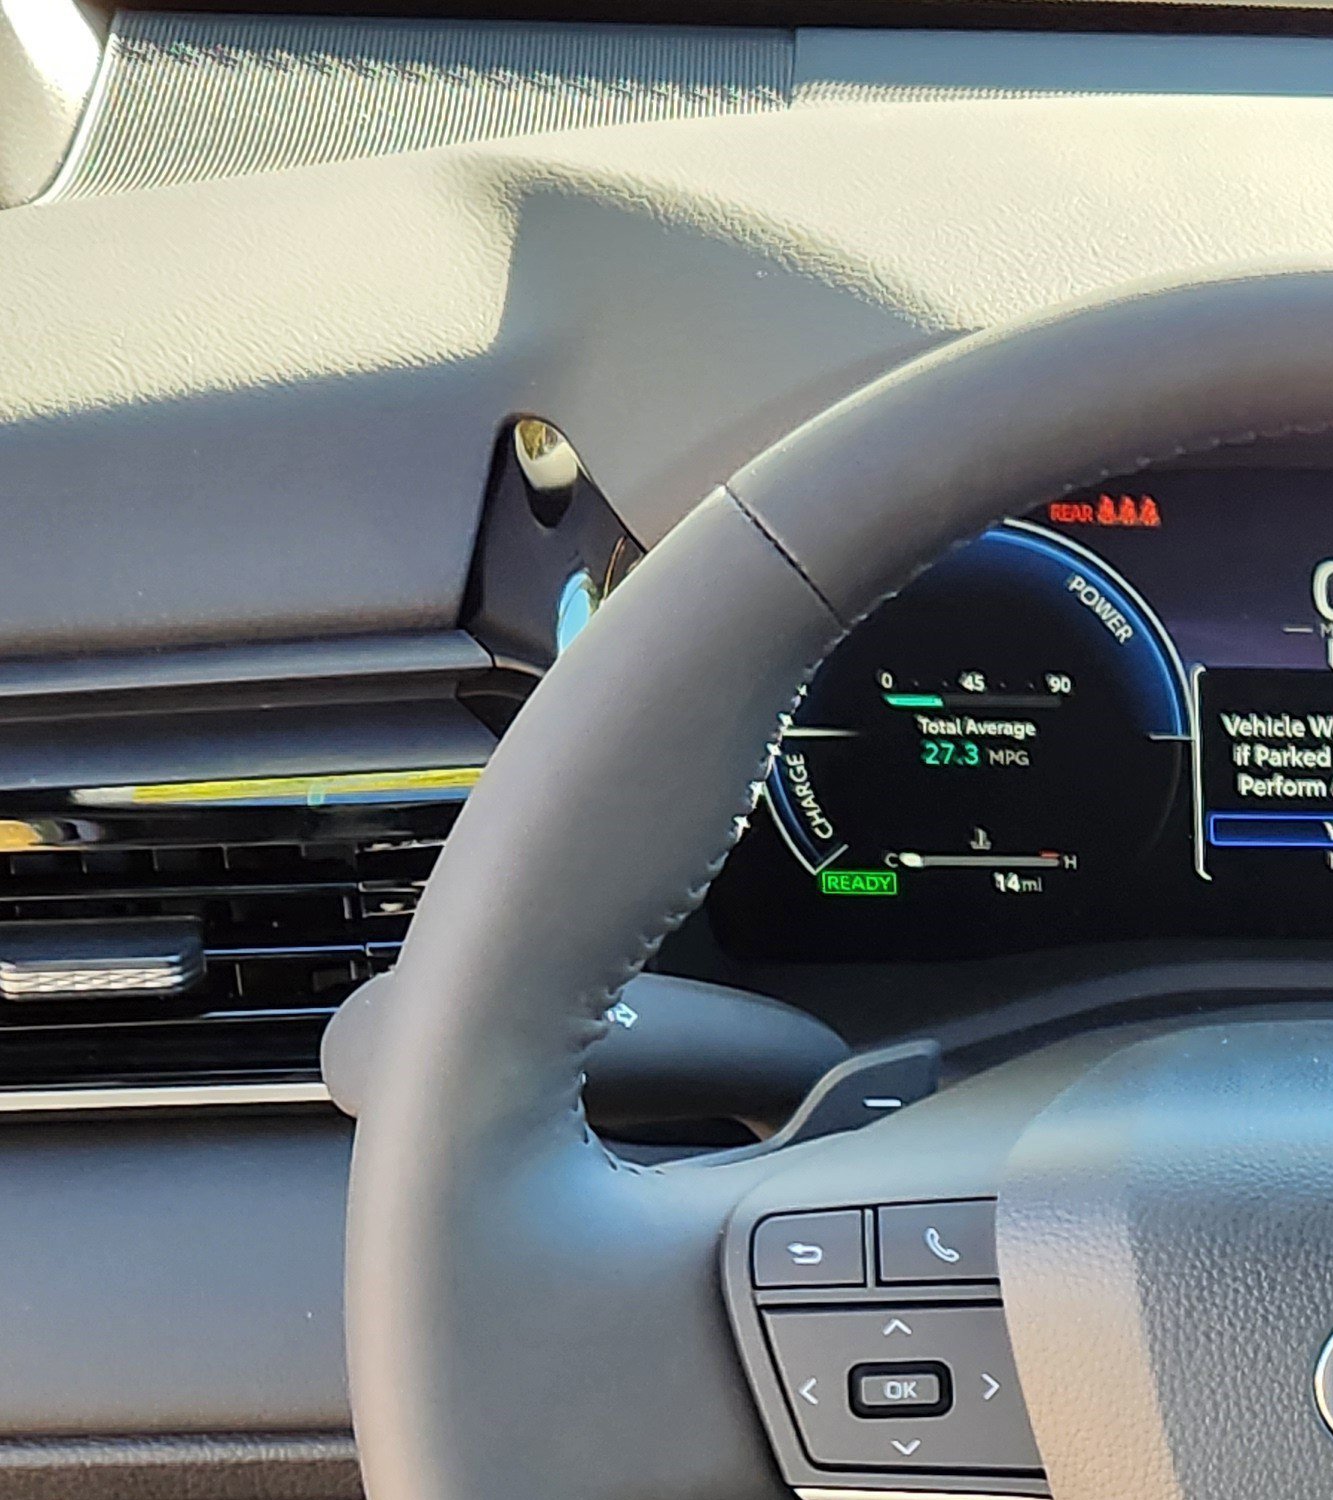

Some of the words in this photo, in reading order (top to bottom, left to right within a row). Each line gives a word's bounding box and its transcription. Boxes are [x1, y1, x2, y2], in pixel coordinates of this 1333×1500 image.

[1050, 504, 1093, 522] REAR
[1068, 574, 1132, 643] POWER
[961, 673, 984, 692] 45
[1046, 675, 1071, 693] 90
[919, 717, 961, 736] Total
[966, 719, 1037, 740] Average
[1220, 713, 1304, 738] Vehicle
[923, 742, 980, 765] 27.3
[988, 749, 1030, 767] MPG
[1255, 746, 1331, 769] Parked
[786, 752, 834, 840] CHARGE
[1237, 775, 1326, 798] Perform
[827, 874, 892, 891] READY
[883, 1381, 917, 1399] OK
